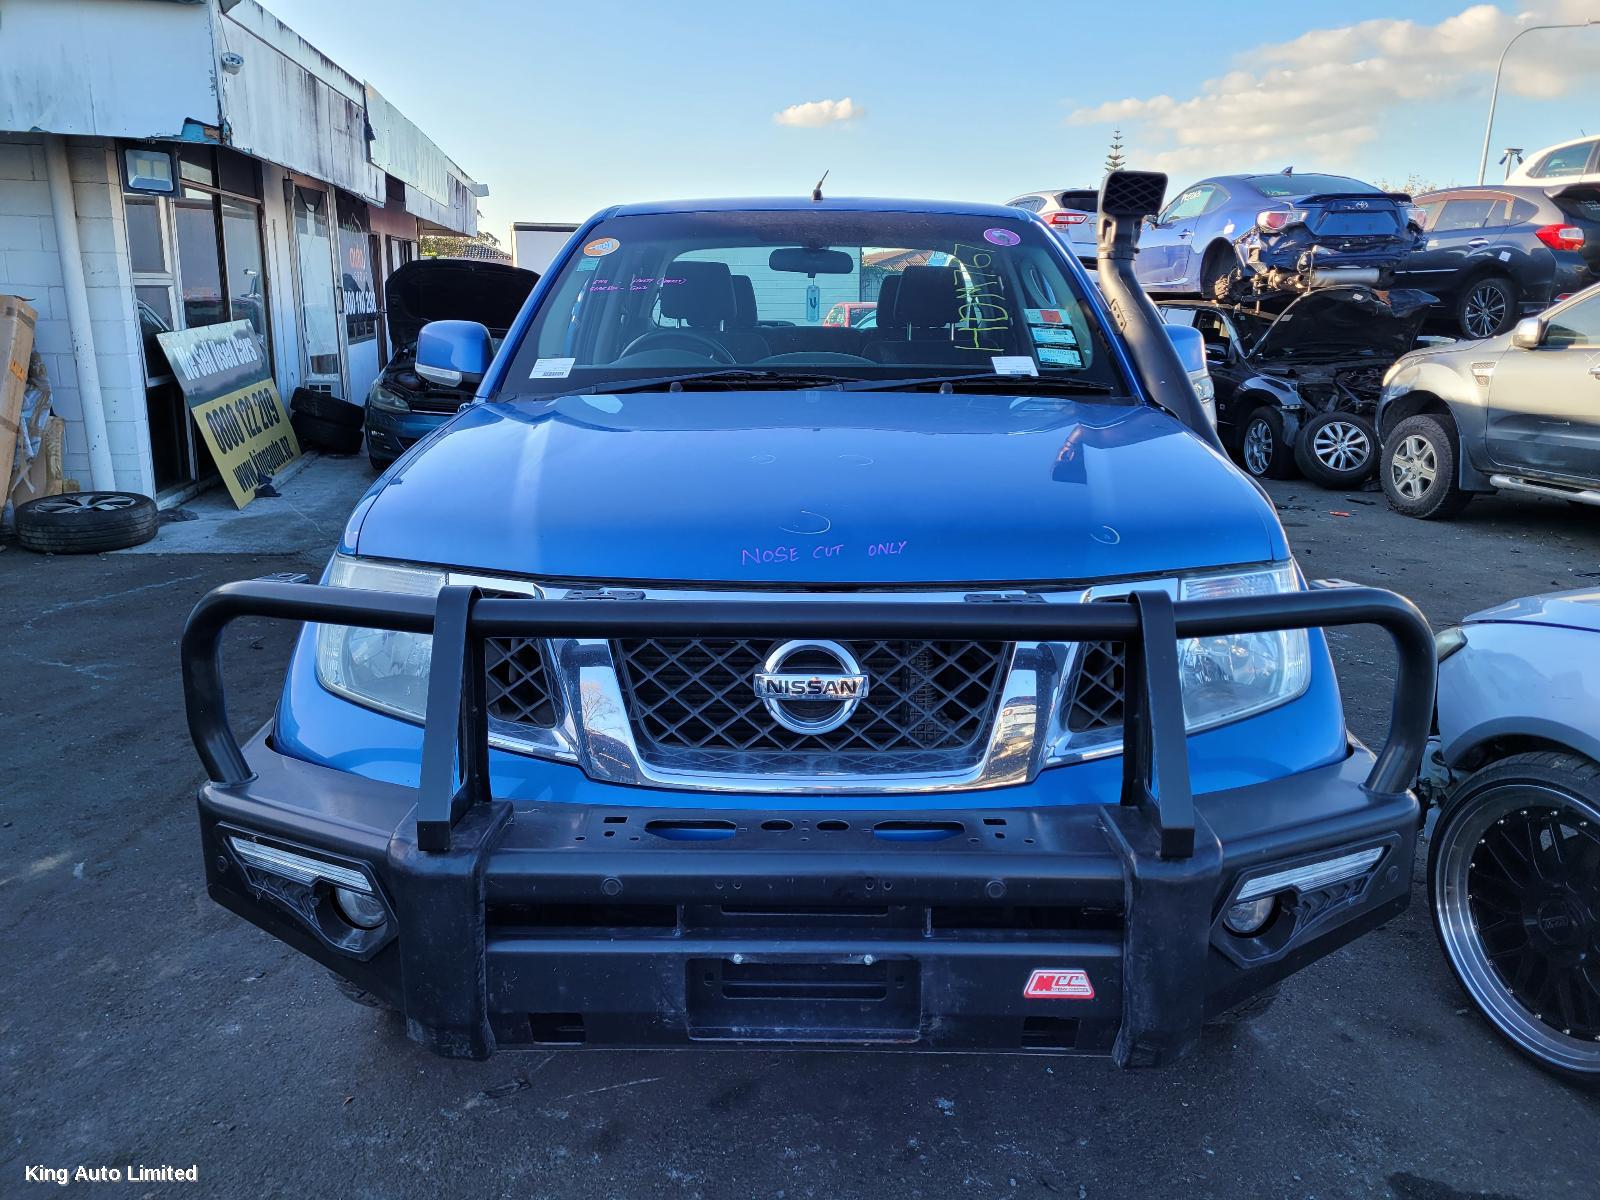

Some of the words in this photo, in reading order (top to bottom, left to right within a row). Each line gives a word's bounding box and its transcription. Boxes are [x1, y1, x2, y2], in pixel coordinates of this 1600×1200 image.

[173, 346, 200, 381] We
[191, 340, 219, 377] Sell
[208, 335, 240, 372] Used
[232, 336, 258, 365] Cars
[205, 403, 246, 455] 0800
[234, 395, 263, 439] 122
[251, 387, 281, 430] 209
[741, 546, 800, 567] NOSE
[812, 543, 844, 560] CUT
[867, 540, 909, 558] ONLY
[765, 678, 859, 696] NISSAN
